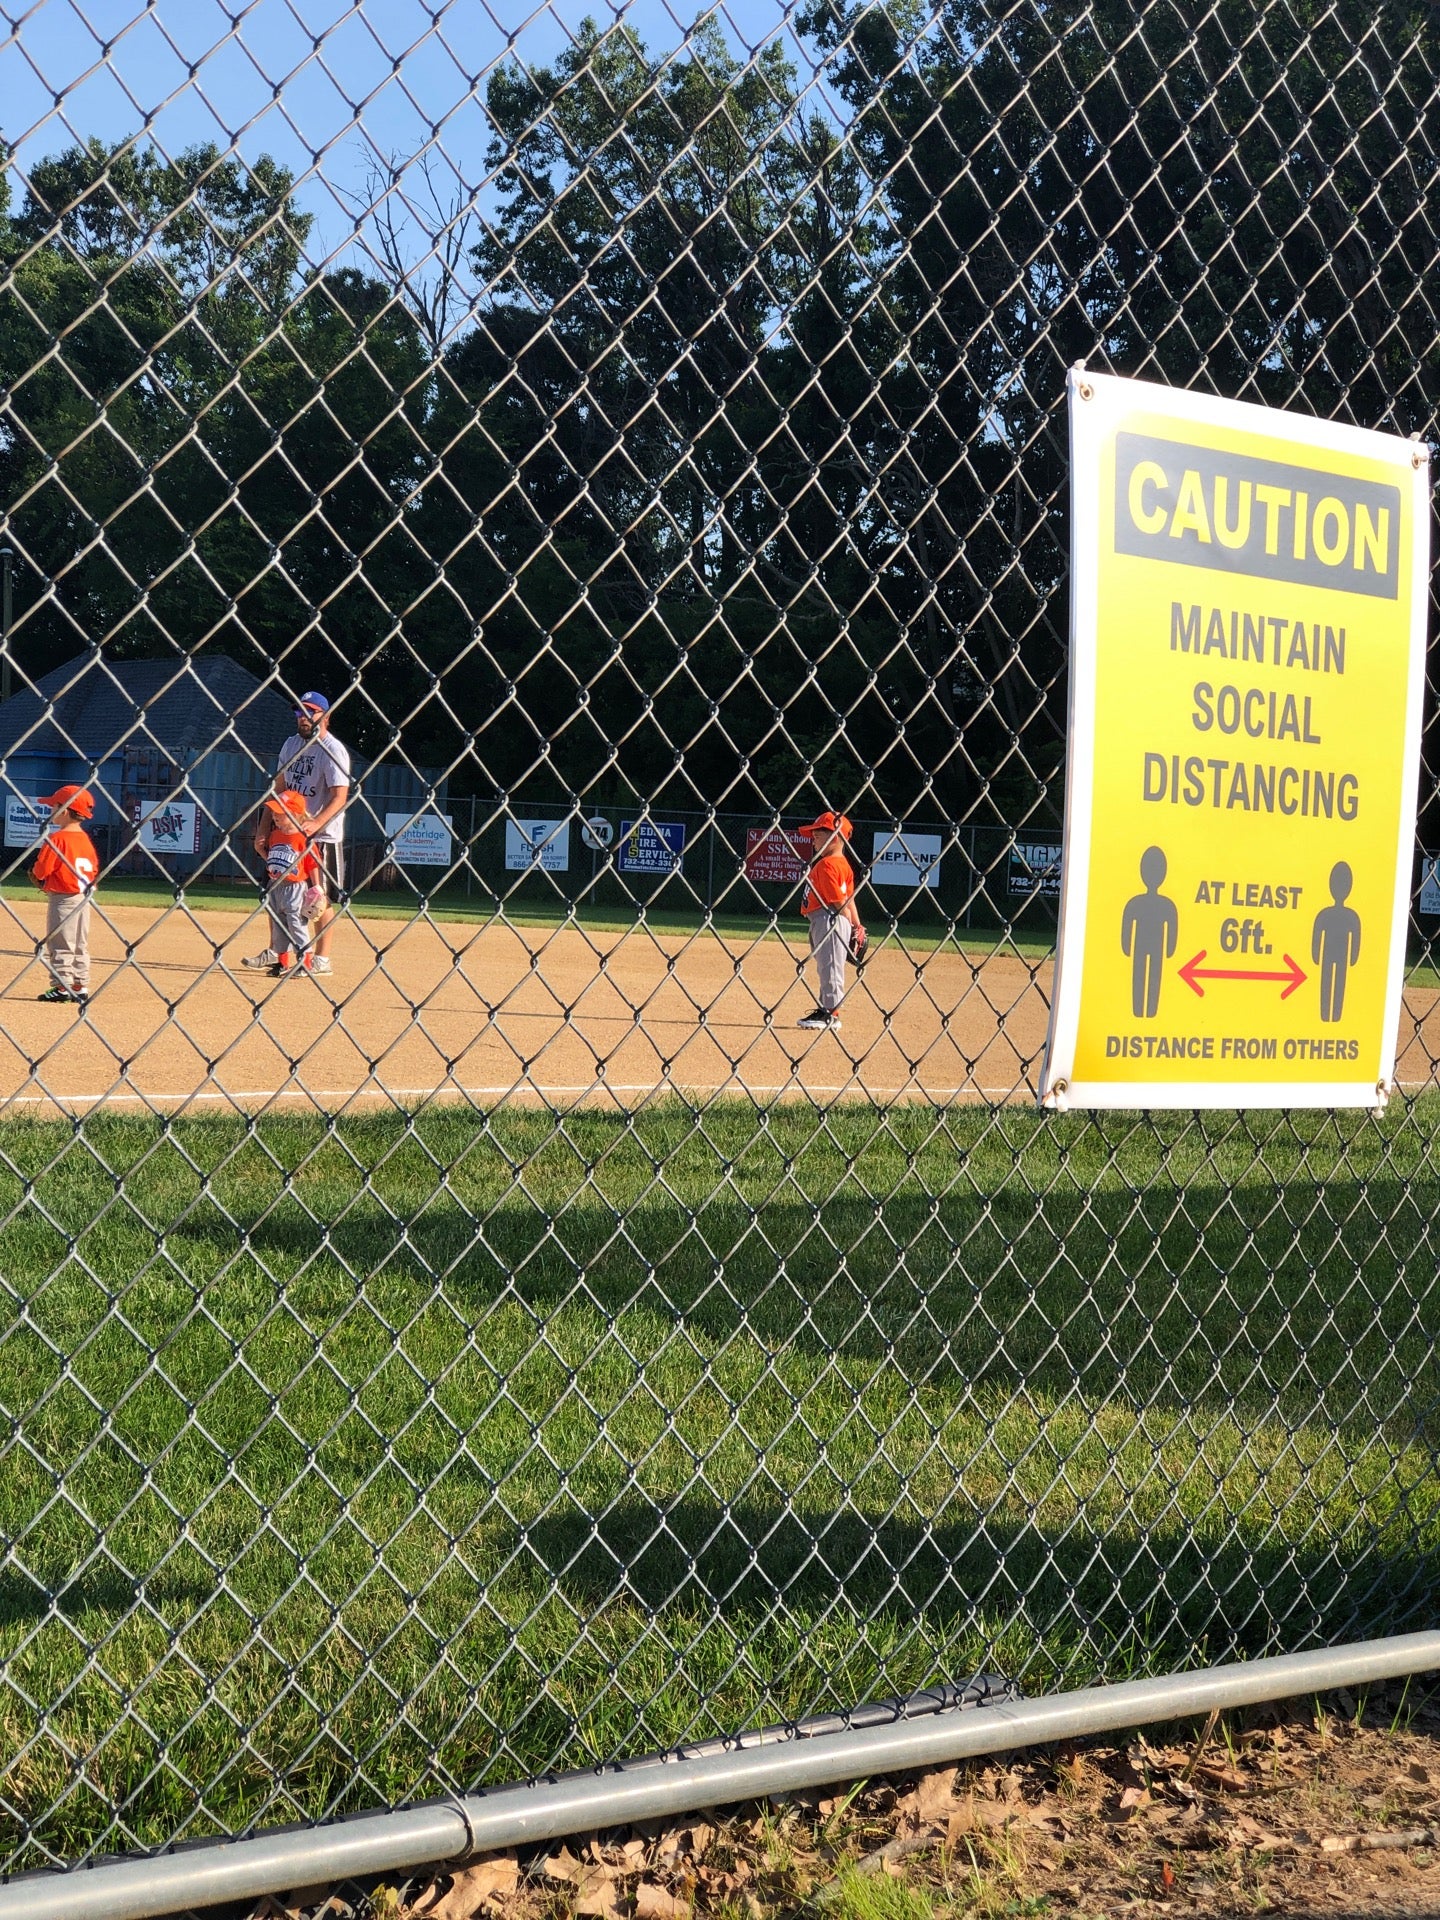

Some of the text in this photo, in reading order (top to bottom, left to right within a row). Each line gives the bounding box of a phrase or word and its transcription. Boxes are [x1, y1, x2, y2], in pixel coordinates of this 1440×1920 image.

[1127, 462, 1390, 574] CAUTION
[1171, 602, 1346, 674] MAINTAIN
[1193, 682, 1321, 744] SOCIAL
[292, 774, 305, 784] ME
[1144, 752, 1359, 826] DISTANCING
[152, 814, 183, 835] ASIT
[1195, 880, 1304, 910] AT LEAST
[1220, 917, 1273, 955] 6ft.
[1106, 1035, 1359, 1060] DISTANCE FROM OTHERS
